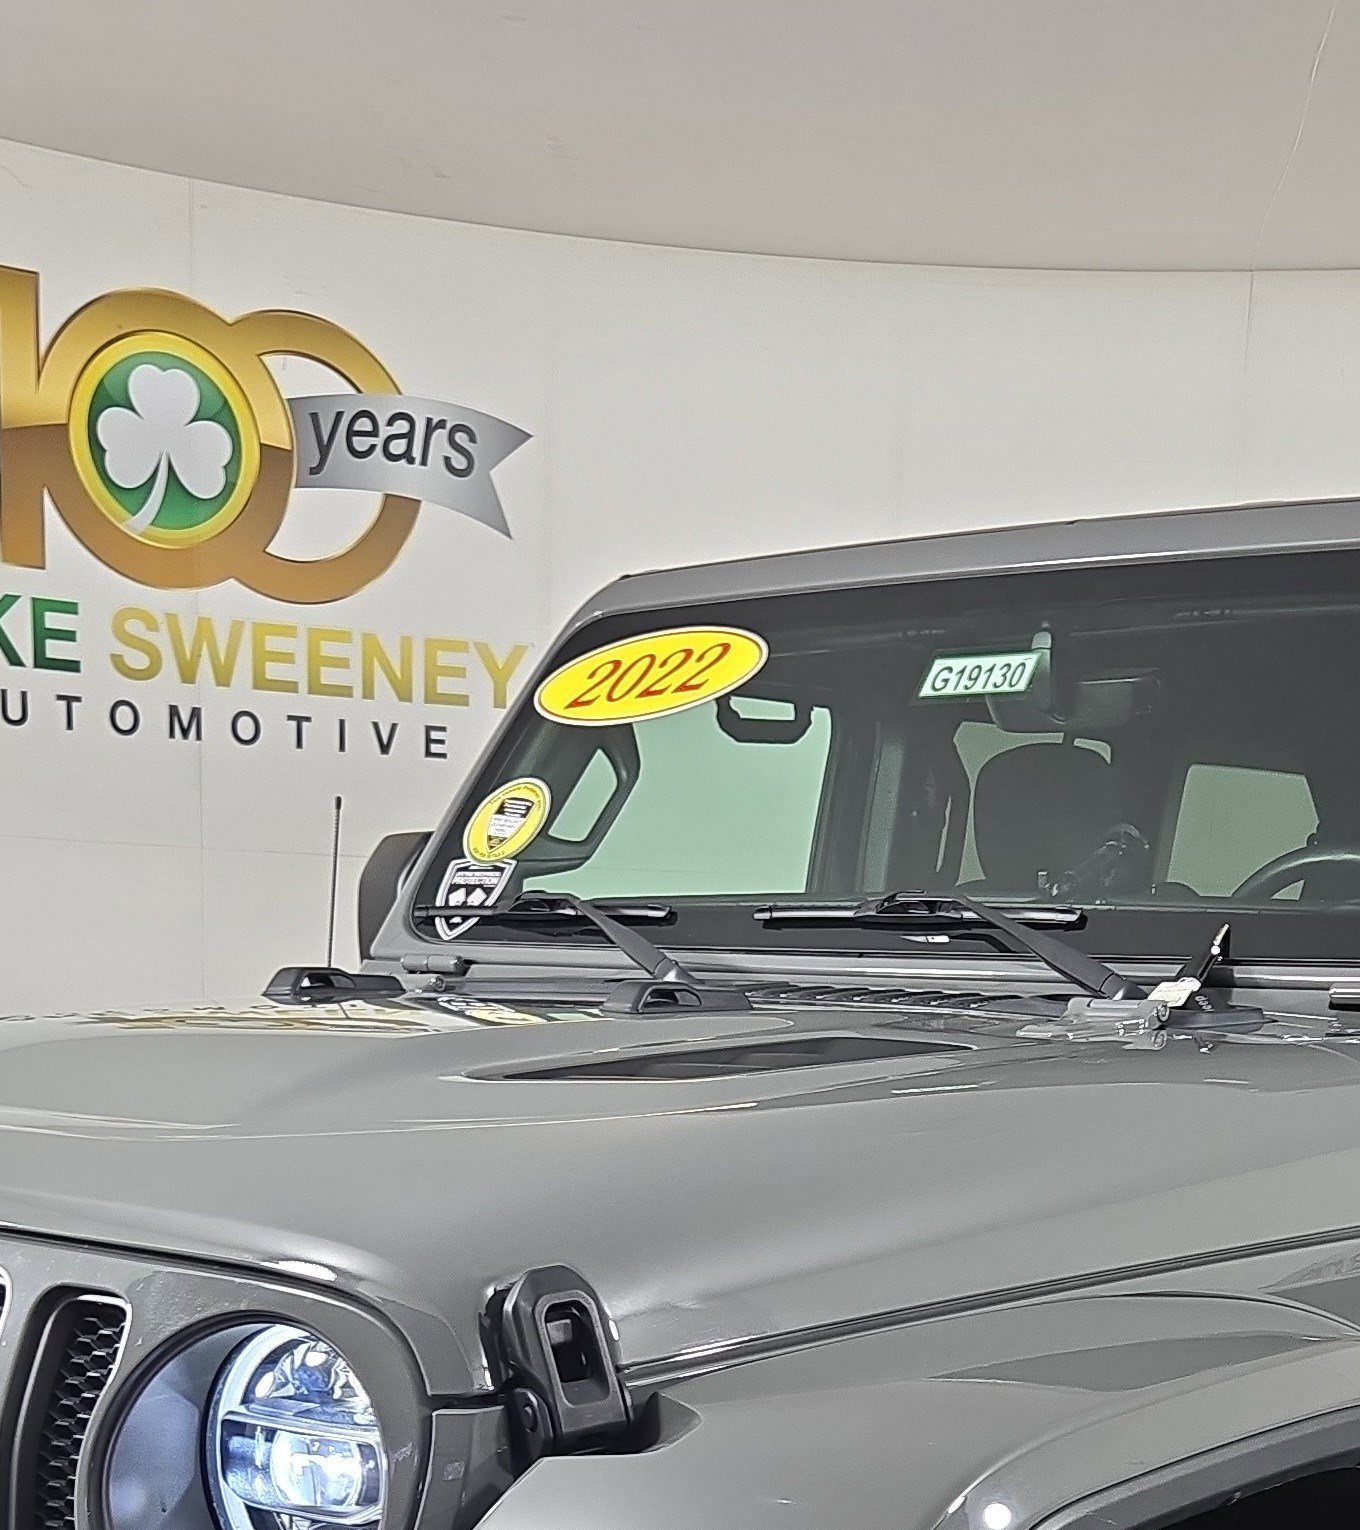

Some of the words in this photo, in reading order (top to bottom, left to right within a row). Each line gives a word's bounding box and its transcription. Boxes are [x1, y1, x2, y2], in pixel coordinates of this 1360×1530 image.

[309, 406, 479, 479] years
[108, 606, 530, 710] SWEENEY
[563, 641, 732, 710] 2022
[930, 661, 1027, 693] G19130
